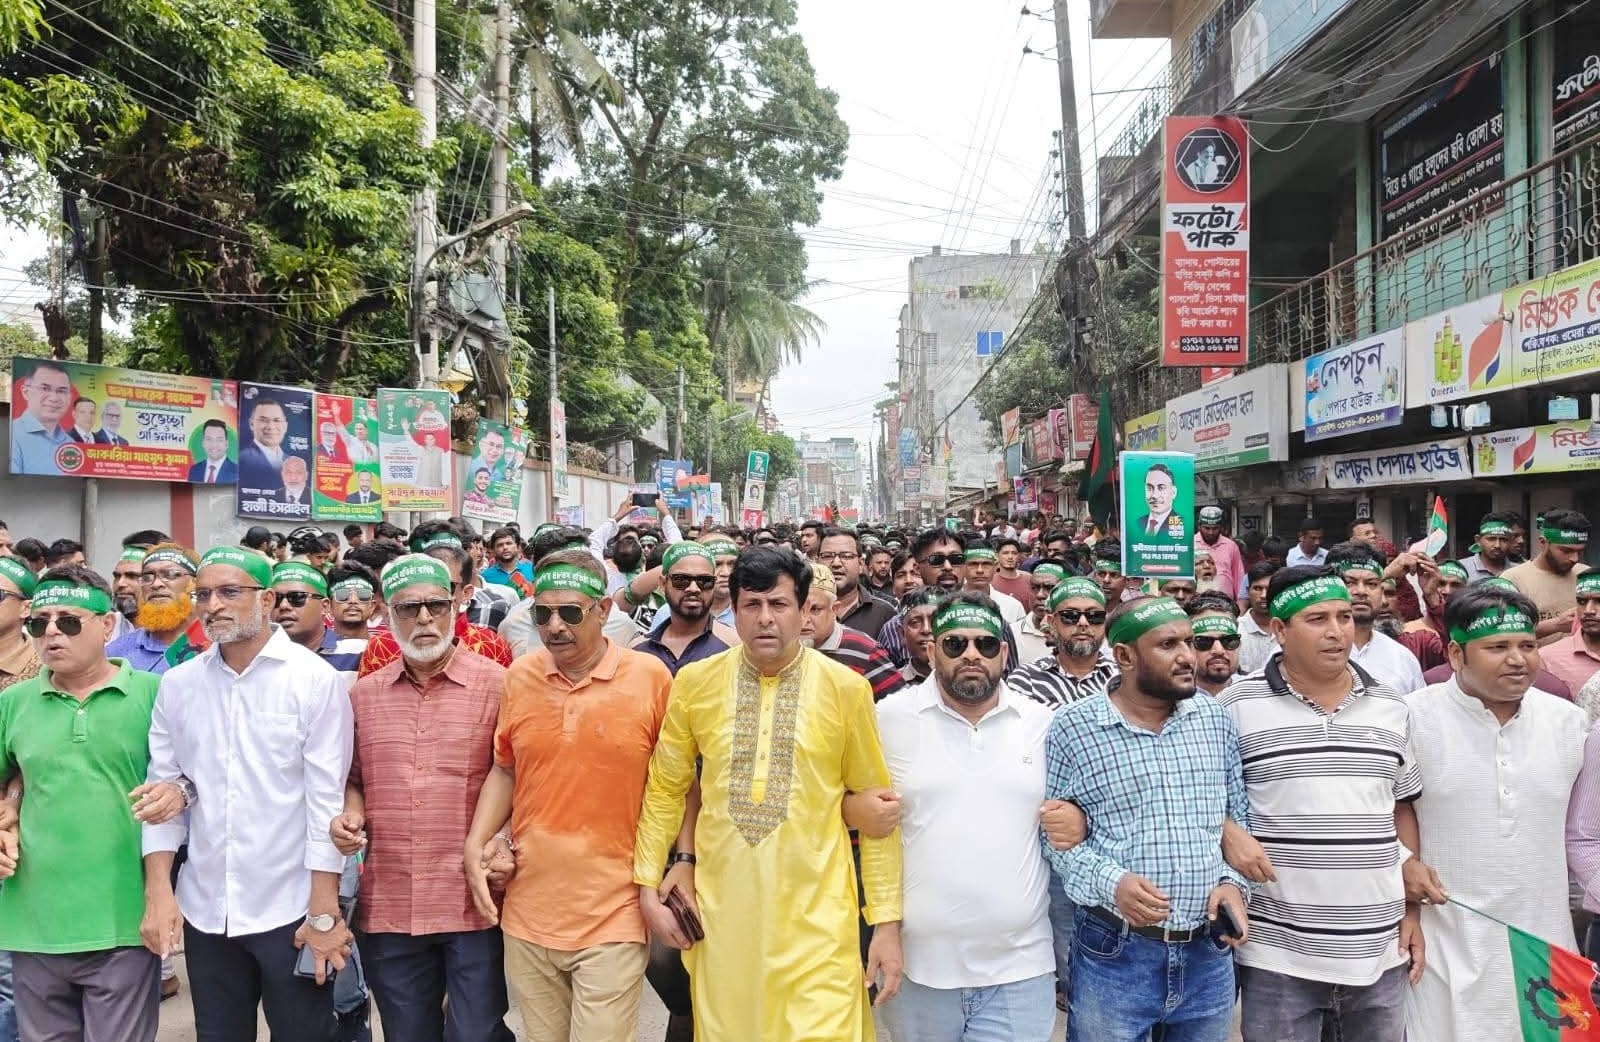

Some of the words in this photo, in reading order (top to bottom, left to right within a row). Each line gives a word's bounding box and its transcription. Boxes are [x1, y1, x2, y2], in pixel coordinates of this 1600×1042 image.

[1401, 174, 1407, 188] ও
[1424, 147, 1449, 176] হলুদের
[1450, 133, 1464, 160] ছবি
[1466, 122, 1488, 151] তোলা
[1490, 113, 1503, 137] হয়
[1172, 205, 1234, 230] ফটো
[1186, 223, 1242, 249] পার্ক
[1518, 287, 1580, 333] মিশুক
[1321, 342, 1385, 388] নেপচুন
[1179, 407, 1201, 430] আয়েশা
[1239, 391, 1254, 416] হল
[1324, 398, 1348, 417] পেপার
[1350, 391, 1373, 410] হাউজ
[136, 410, 185, 428] শুভেচ্ছা
[137, 428, 185, 444] অভিনন্দন
[1334, 458, 1373, 484] নেপচুন
[1377, 453, 1416, 476] পেপার
[1416, 443, 1463, 472] হাউজ
[241, 500, 268, 513] হাজী
[269, 500, 310, 515] ইসরাইল
